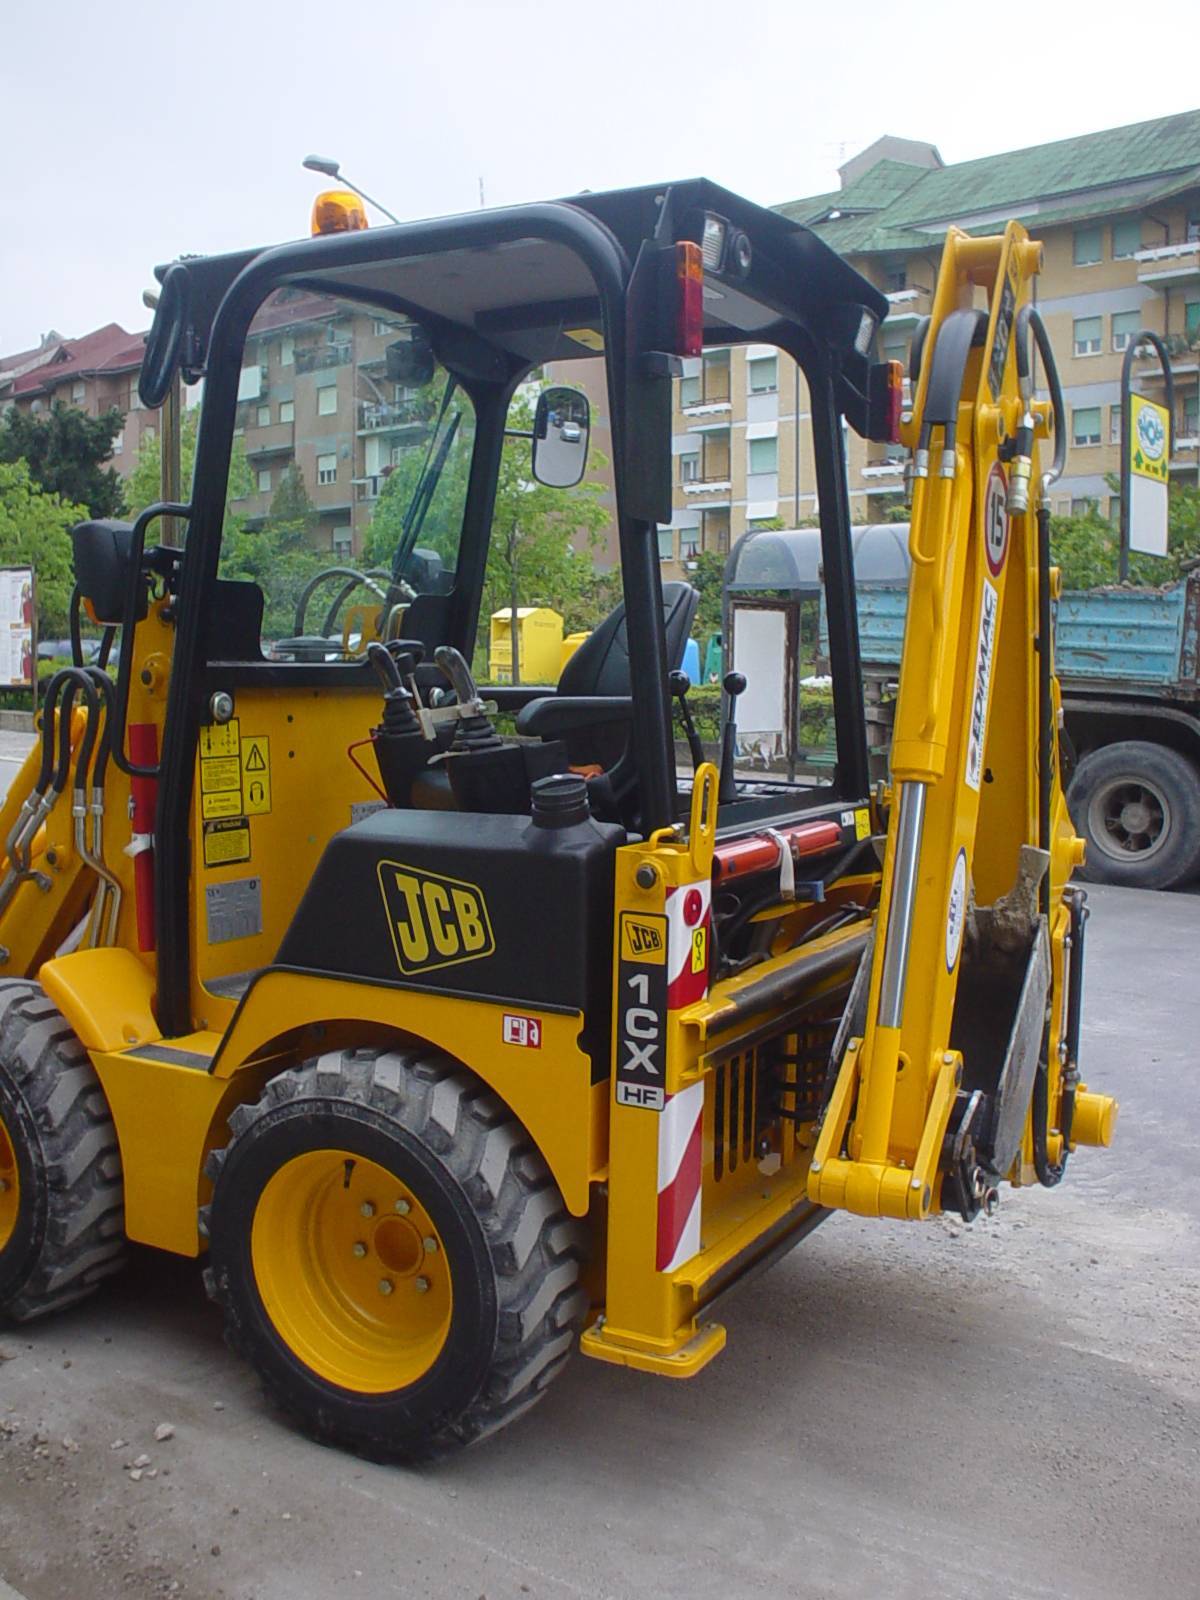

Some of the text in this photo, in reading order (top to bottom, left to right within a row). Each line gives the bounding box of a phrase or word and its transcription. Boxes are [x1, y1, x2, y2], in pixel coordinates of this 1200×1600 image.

[991, 492, 1004, 547] 15
[394, 872, 486, 963] JCB
[631, 925, 660, 952] JCB
[623, 1086, 657, 1105] HF
